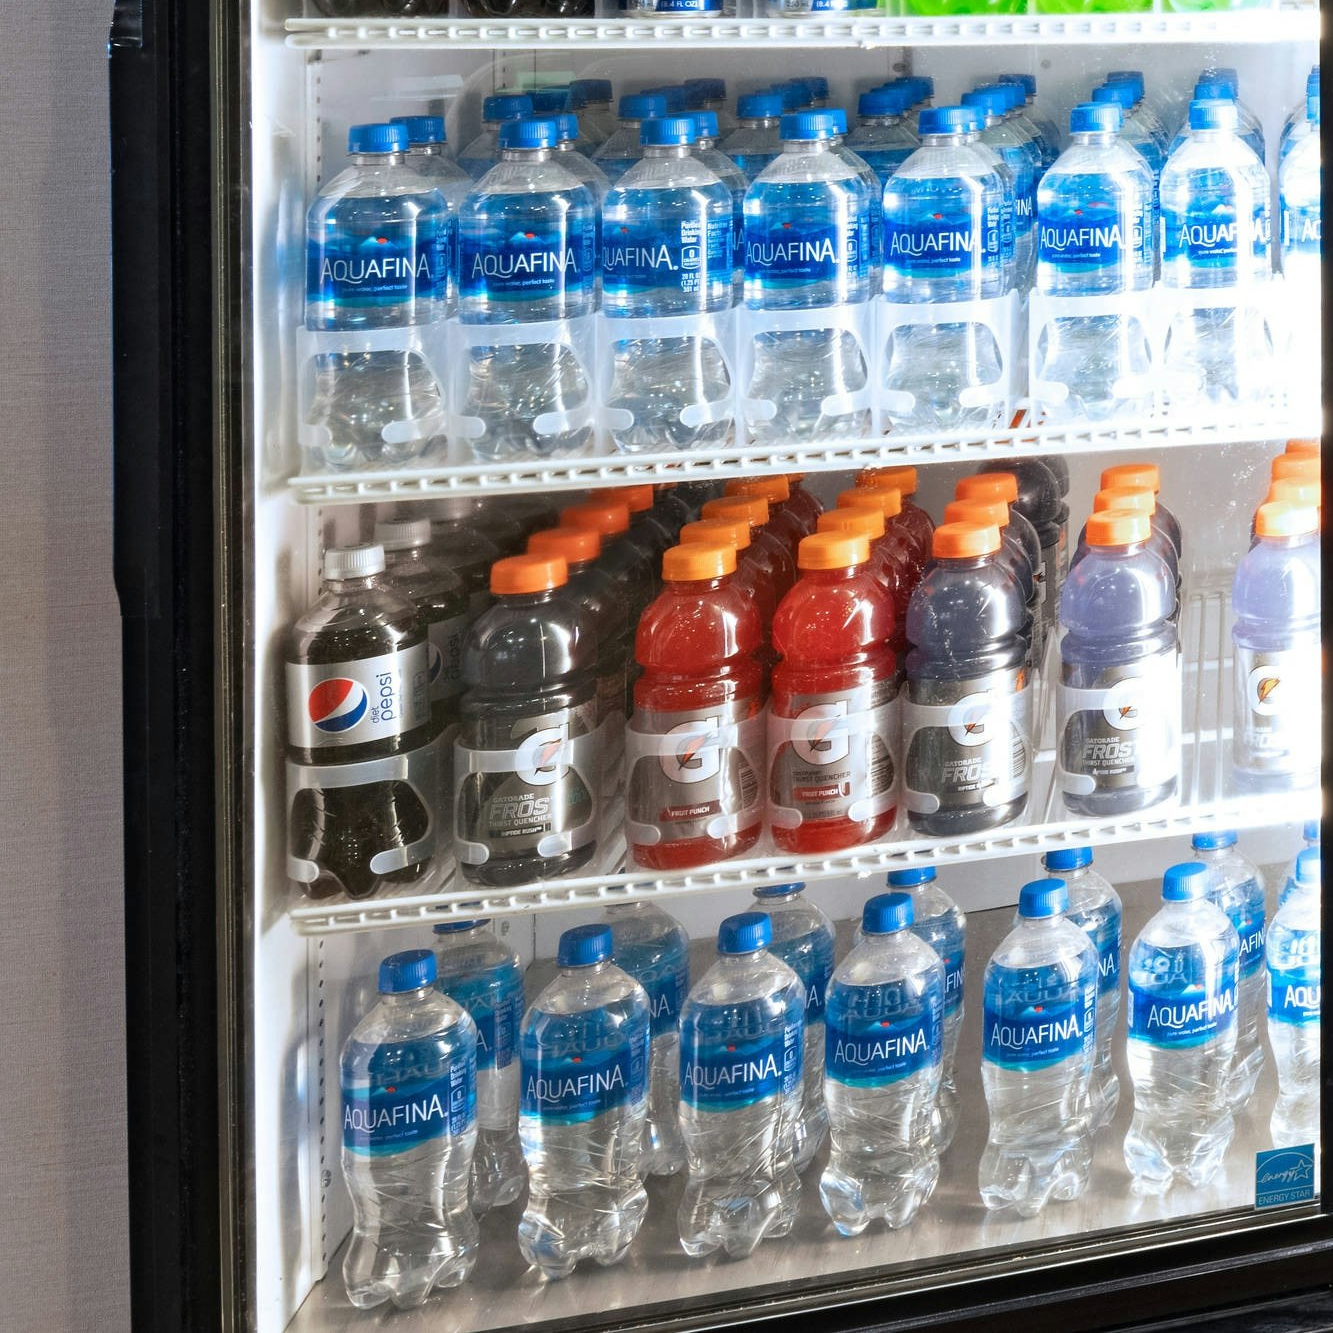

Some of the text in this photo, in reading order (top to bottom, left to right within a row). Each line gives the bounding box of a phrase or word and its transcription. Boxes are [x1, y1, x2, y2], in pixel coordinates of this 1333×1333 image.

[746, 237, 836, 266] AQUAFINA
[890, 229, 980, 257] AQUAFINA
[1040, 223, 1124, 253] AQUAFINA
[321, 252, 431, 284] AQUAFINA
[471, 250, 575, 278] AQUAFINA
[602, 244, 673, 271] QUAFINA
[379, 672, 398, 721] pepsi
[370, 705, 380, 724] diet
[944, 757, 983, 767] GATORADE
[489, 797, 550, 819] FROS
[491, 793, 535, 804] GATORADE
[671, 805, 710, 817] FRUIT PUNCH
[1147, 994, 1235, 1029] AQUAFINA
[834, 1027, 928, 1064] AQUAFINA
[990, 1018, 1080, 1050] AQUAFINA
[526, 1063, 626, 1103] AQUAFINA
[684, 1052, 777, 1088] AQUAFINA
[343, 1092, 446, 1133] AQUAFINA
[1258, 1189, 1311, 1206] ENERGY STAR
